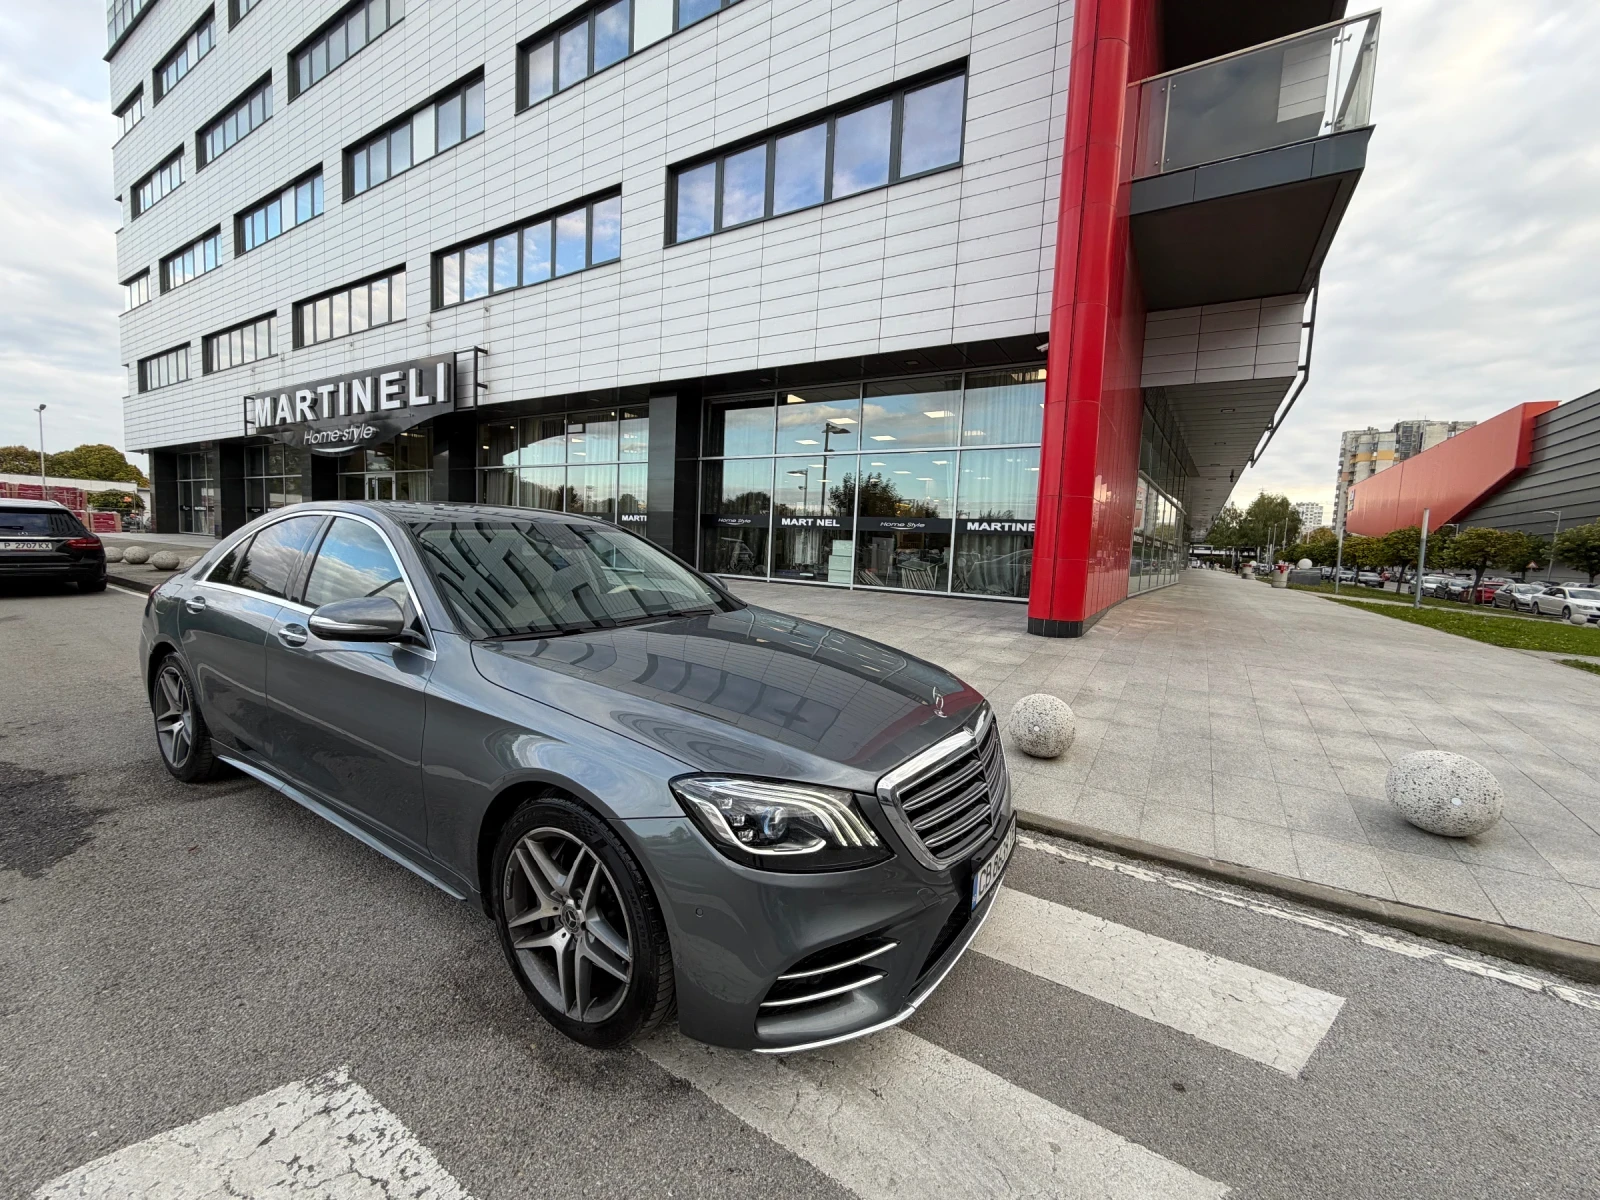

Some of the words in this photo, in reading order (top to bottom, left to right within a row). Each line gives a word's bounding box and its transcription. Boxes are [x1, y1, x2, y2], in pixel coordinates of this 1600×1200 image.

[255, 361, 449, 428] MARTINELI
[303, 429, 340, 445] Home
[342, 423, 373, 444] style
[621, 514, 647, 522] MARTI
[906, 521, 926, 529] Style
[966, 521, 1036, 532] MARTINE
